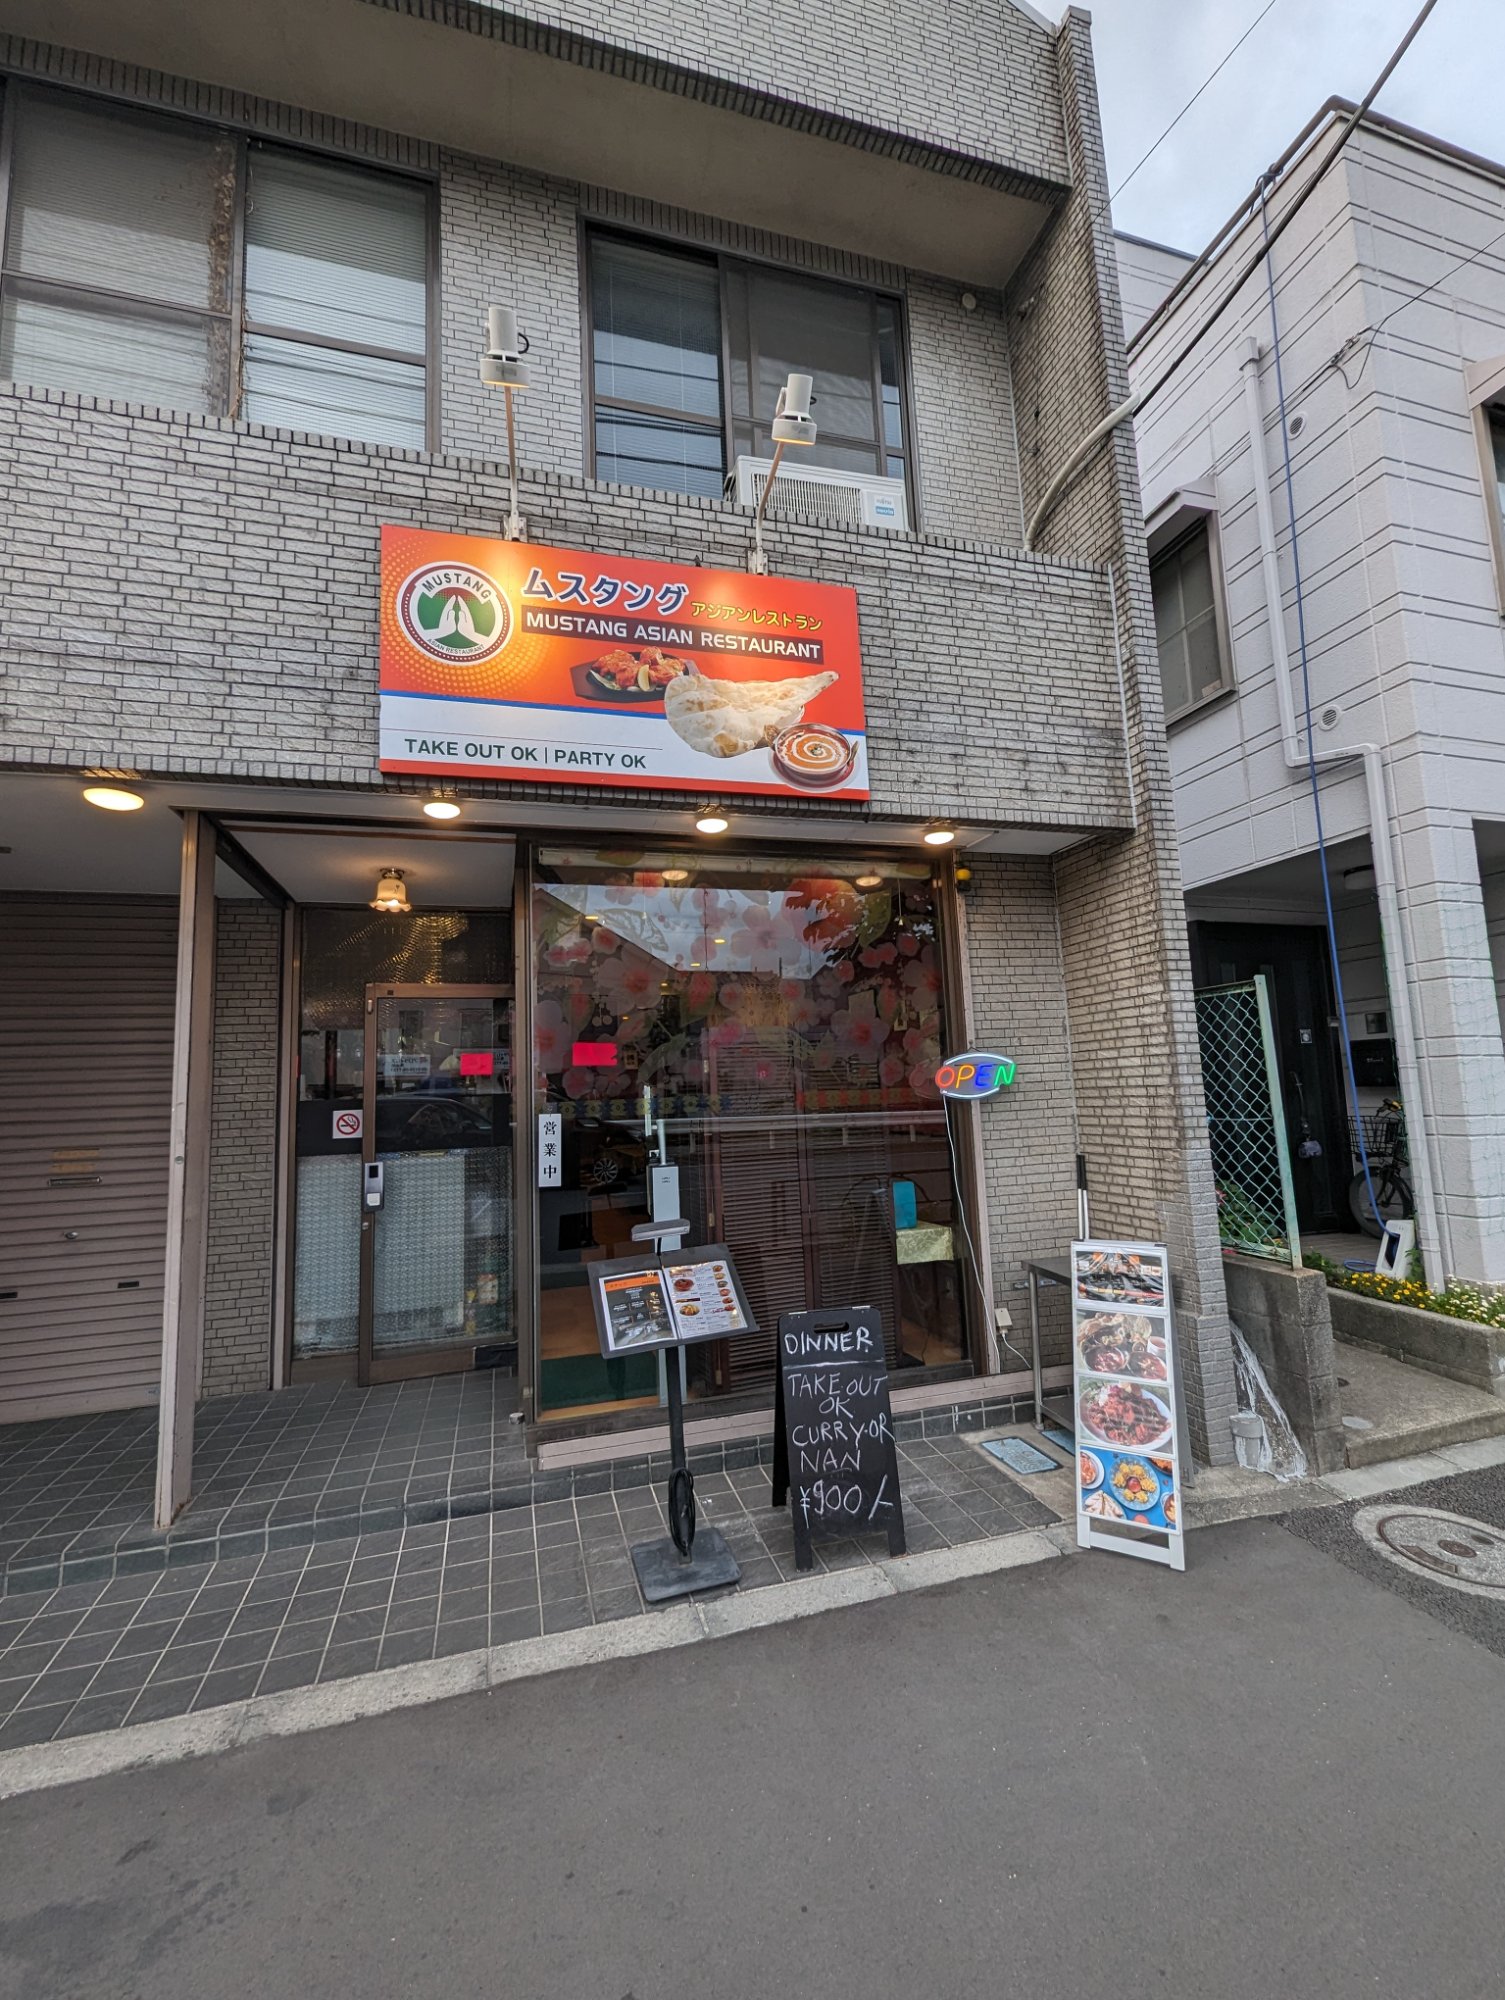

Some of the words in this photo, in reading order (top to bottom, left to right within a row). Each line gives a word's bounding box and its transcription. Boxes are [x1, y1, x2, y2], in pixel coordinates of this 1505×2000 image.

[422, 573, 492, 599] MUSTANG
[522, 568, 688, 614] ムスタング
[691, 601, 823, 631] アジアンレストラン
[428, 639, 445, 650] ASIAN
[445, 645, 485, 655] RESTAURANT
[526, 611, 627, 638] MUSTANG
[634, 624, 693, 645] ASIAN
[701, 632, 821, 659] RESTAURANT
[404, 738, 459, 756] TAKE
[464, 742, 505, 759] OUT
[511, 746, 538, 761] OK
[554, 749, 616, 767] PARTY
[621, 754, 646, 769] OK
[935, 1063, 1016, 1089] OPEN
[543, 1120, 557, 1179] 営業中
[784, 1326, 873, 1355] DINNER
[818, 1396, 854, 1419] OK
[800, 1447, 861, 1473] NAN
